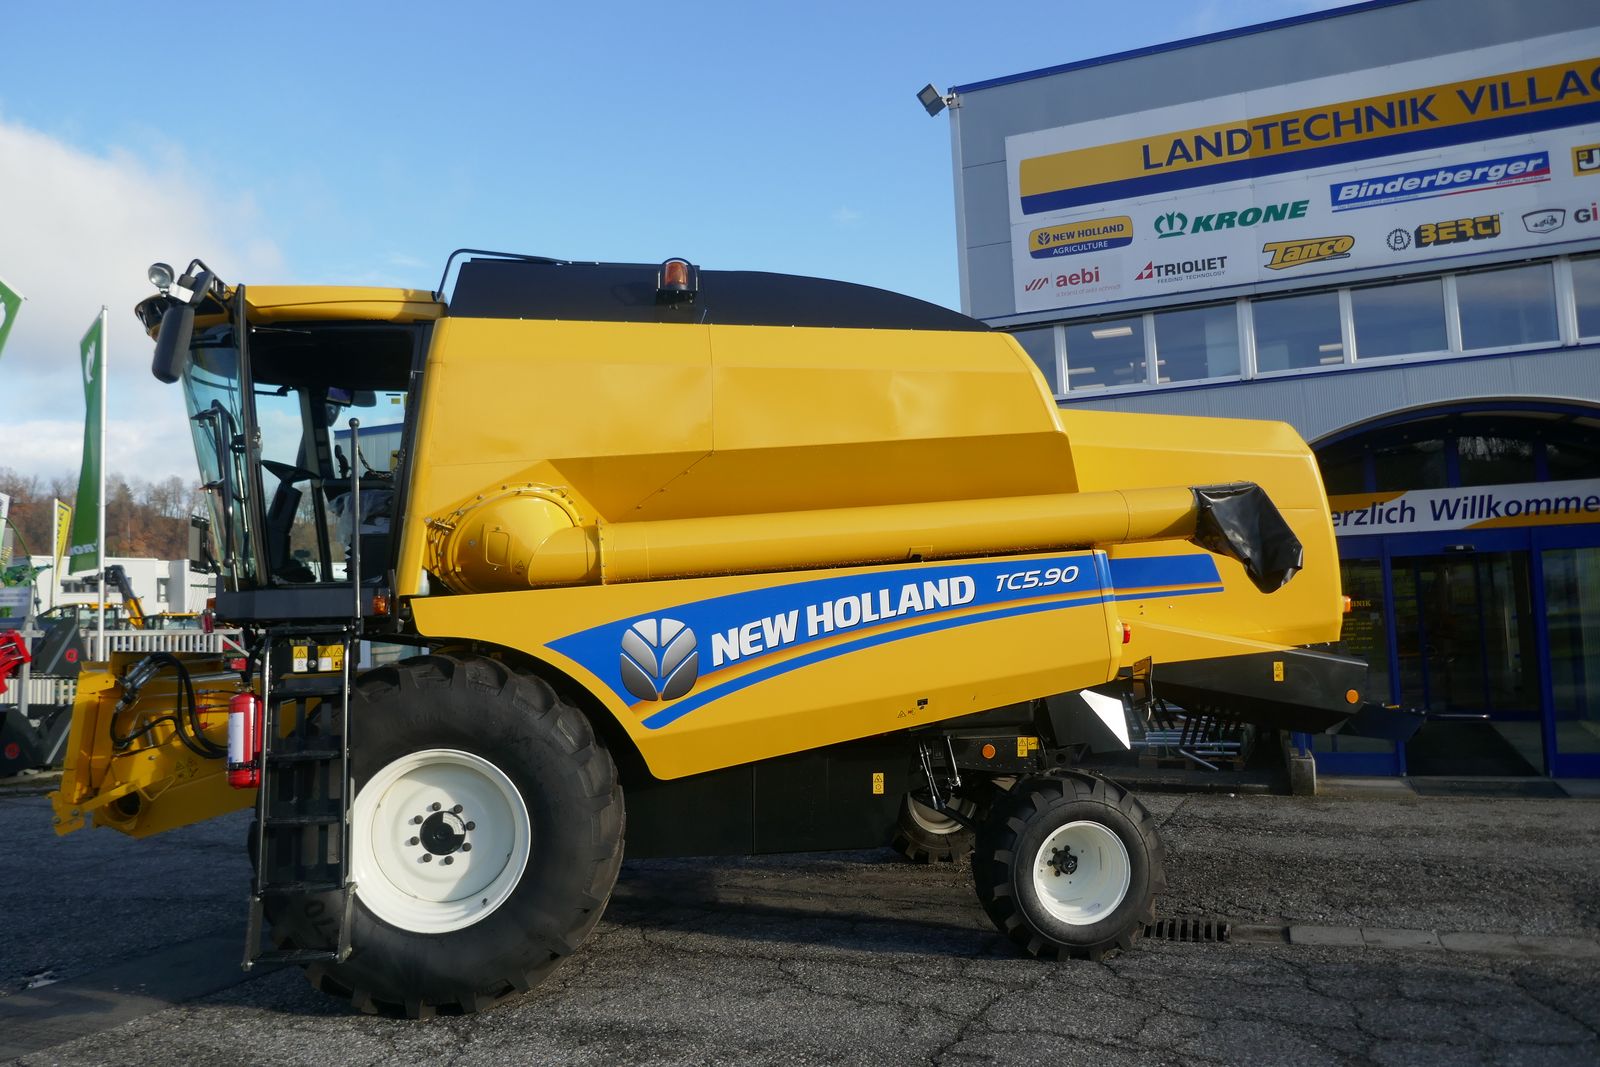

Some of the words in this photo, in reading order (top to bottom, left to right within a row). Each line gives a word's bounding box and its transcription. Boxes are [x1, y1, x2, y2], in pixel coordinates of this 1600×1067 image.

[1142, 94, 1440, 171] LANDTECHNIK
[1337, 157, 1543, 201] Binderberger
[1191, 200, 1310, 234] KRONE
[1052, 231, 1075, 242] NEW
[1077, 223, 1124, 238] HOLLAND
[1052, 240, 1109, 255] AGRICULTURE
[1154, 256, 1227, 278] TRIOLIET
[1263, 236, 1355, 270] Tanco
[1056, 266, 1100, 287] aebi
[995, 565, 1080, 592] TC5.90
[711, 609, 799, 667] NEW
[806, 575, 976, 638] HOLLAND
